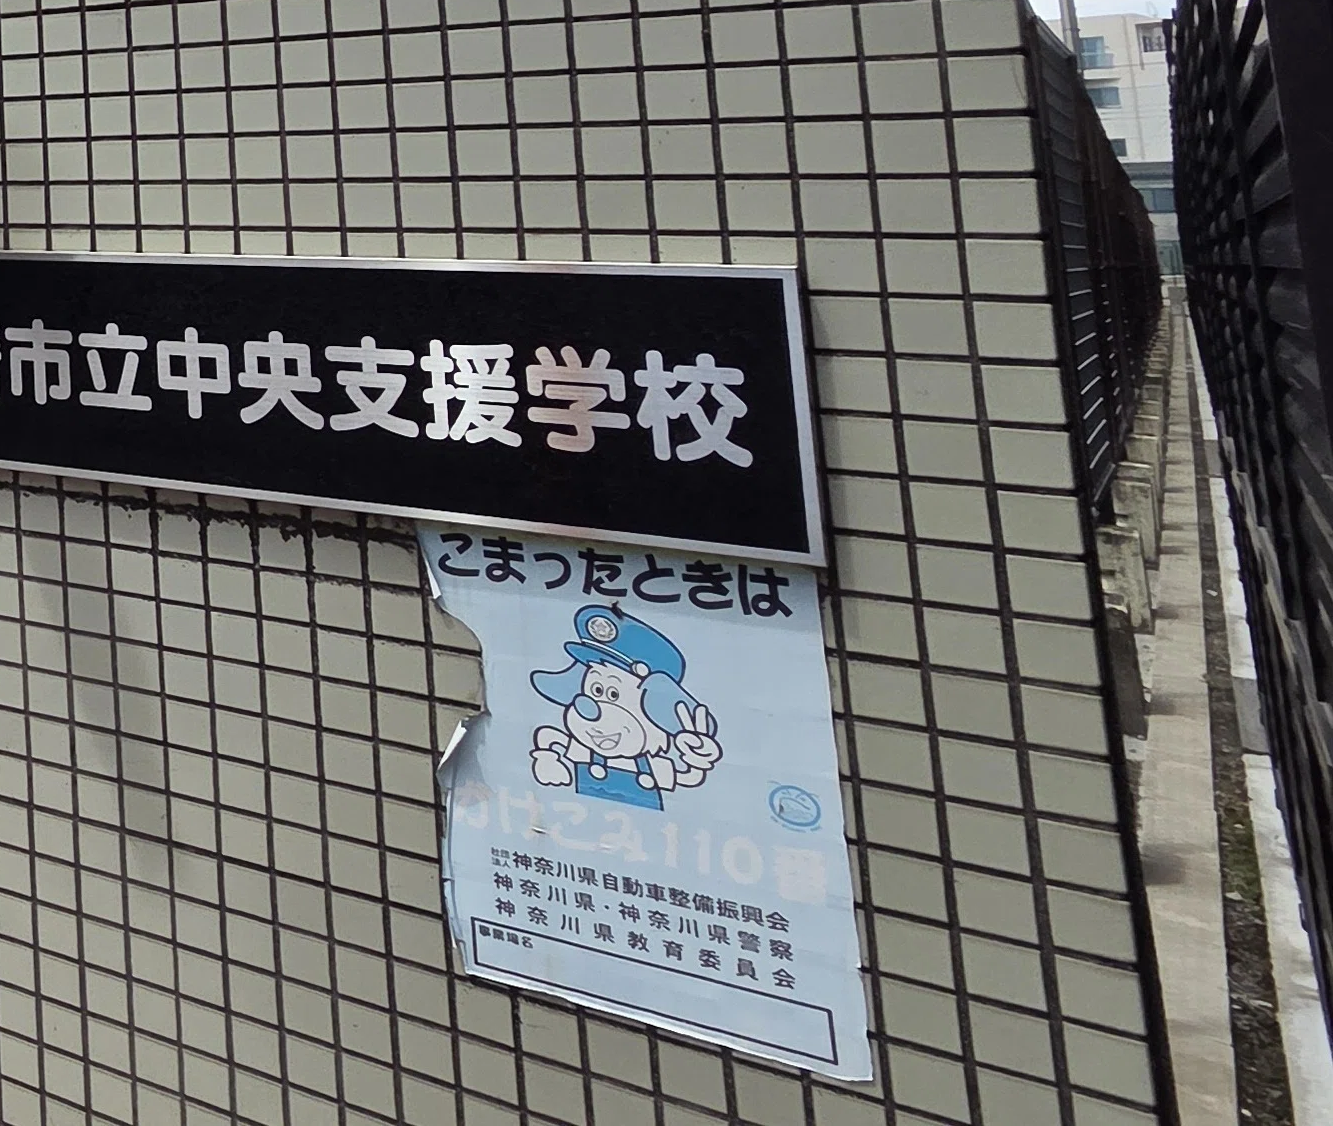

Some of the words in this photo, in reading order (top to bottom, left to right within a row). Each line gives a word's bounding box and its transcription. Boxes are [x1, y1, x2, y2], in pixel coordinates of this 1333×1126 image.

[437, 532, 794, 619] こまったときは
[493, 871, 794, 963] 神奈川県・神奈川県警察
[512, 850, 790, 934] 神奈川県自動車整備振興会
[494, 896, 796, 991] 神奈川県教育委員会
